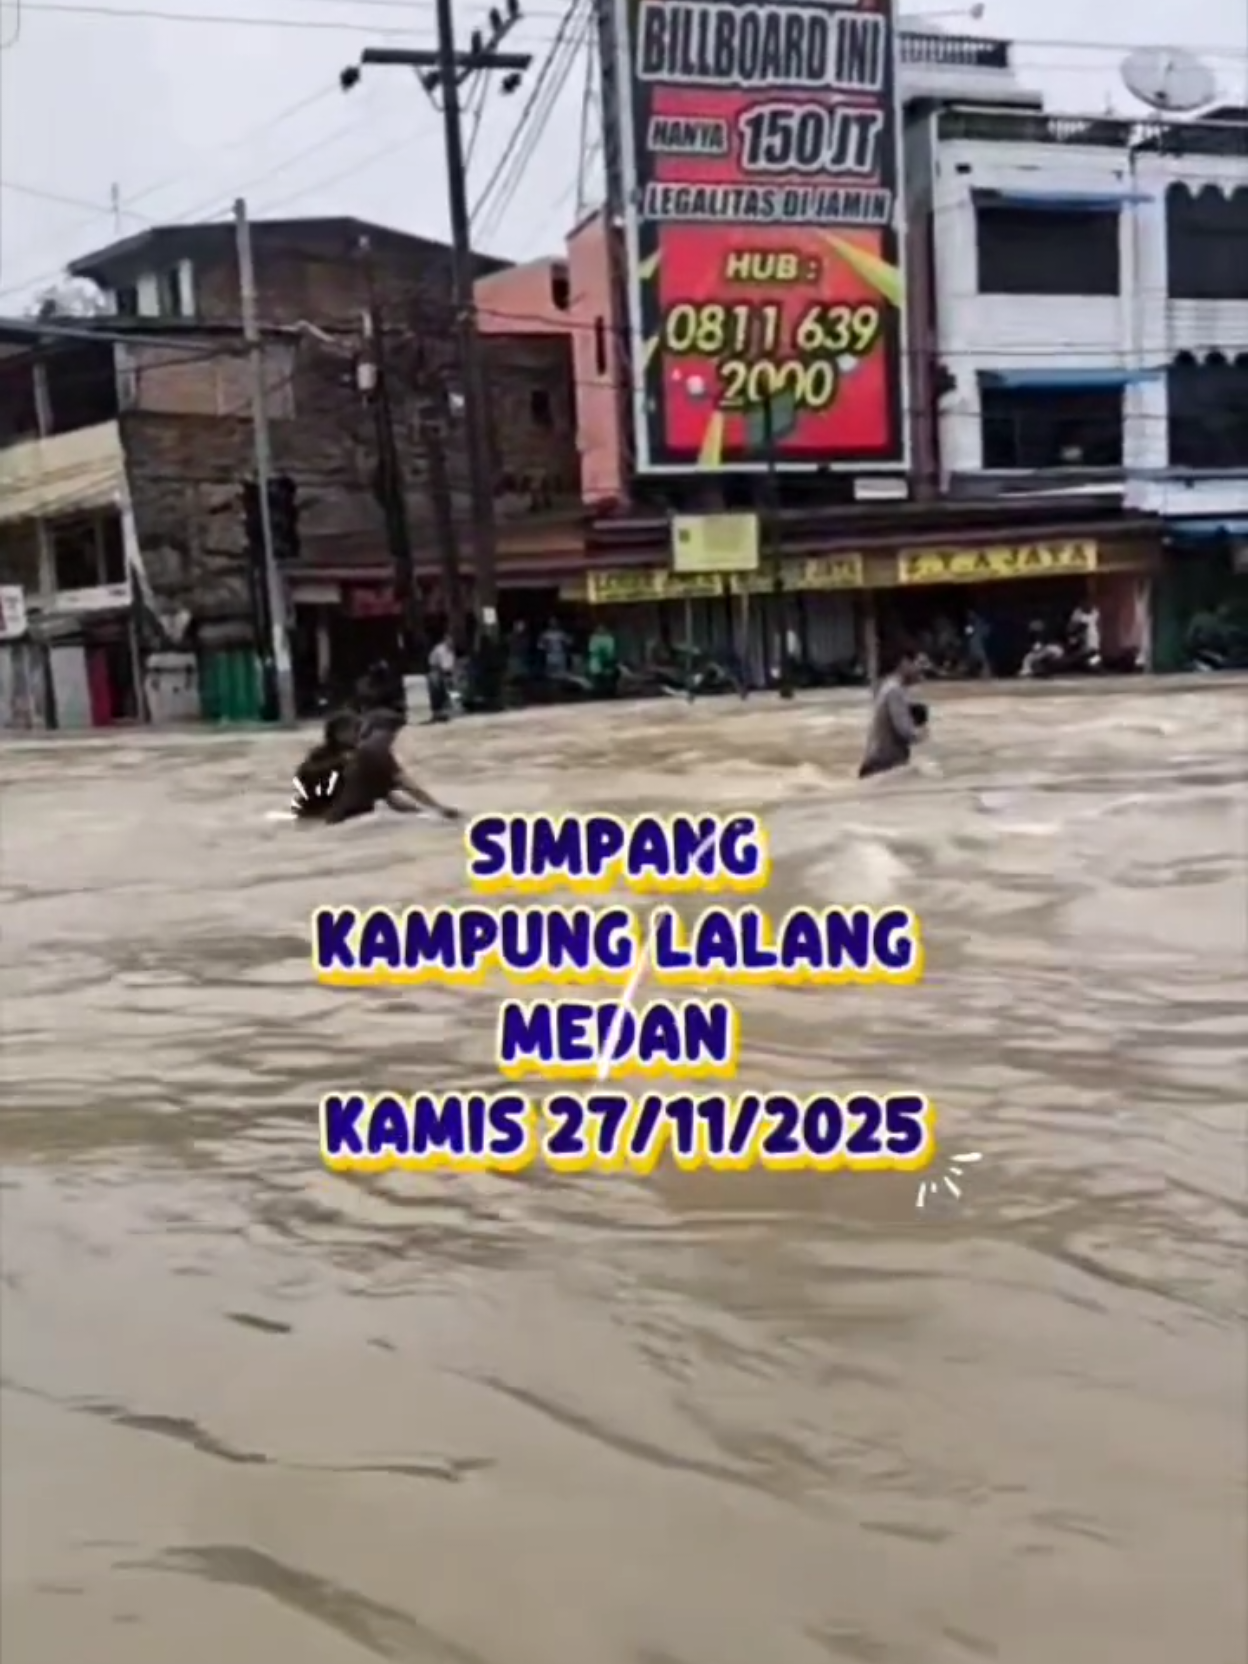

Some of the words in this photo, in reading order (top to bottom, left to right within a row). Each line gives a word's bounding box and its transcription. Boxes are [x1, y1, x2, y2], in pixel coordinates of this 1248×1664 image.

[640, 3, 830, 84] BILLBOARD
[834, 15, 884, 88] INI
[651, 117, 725, 151] HANYA
[741, 106, 827, 168] 150
[829, 109, 880, 170] JT
[647, 183, 776, 218] LEGALITAS
[781, 188, 808, 219] DI
[813, 190, 889, 222] JAMIN
[725, 252, 799, 280] HUB
[666, 304, 778, 351] 0811
[796, 305, 879, 351] 639
